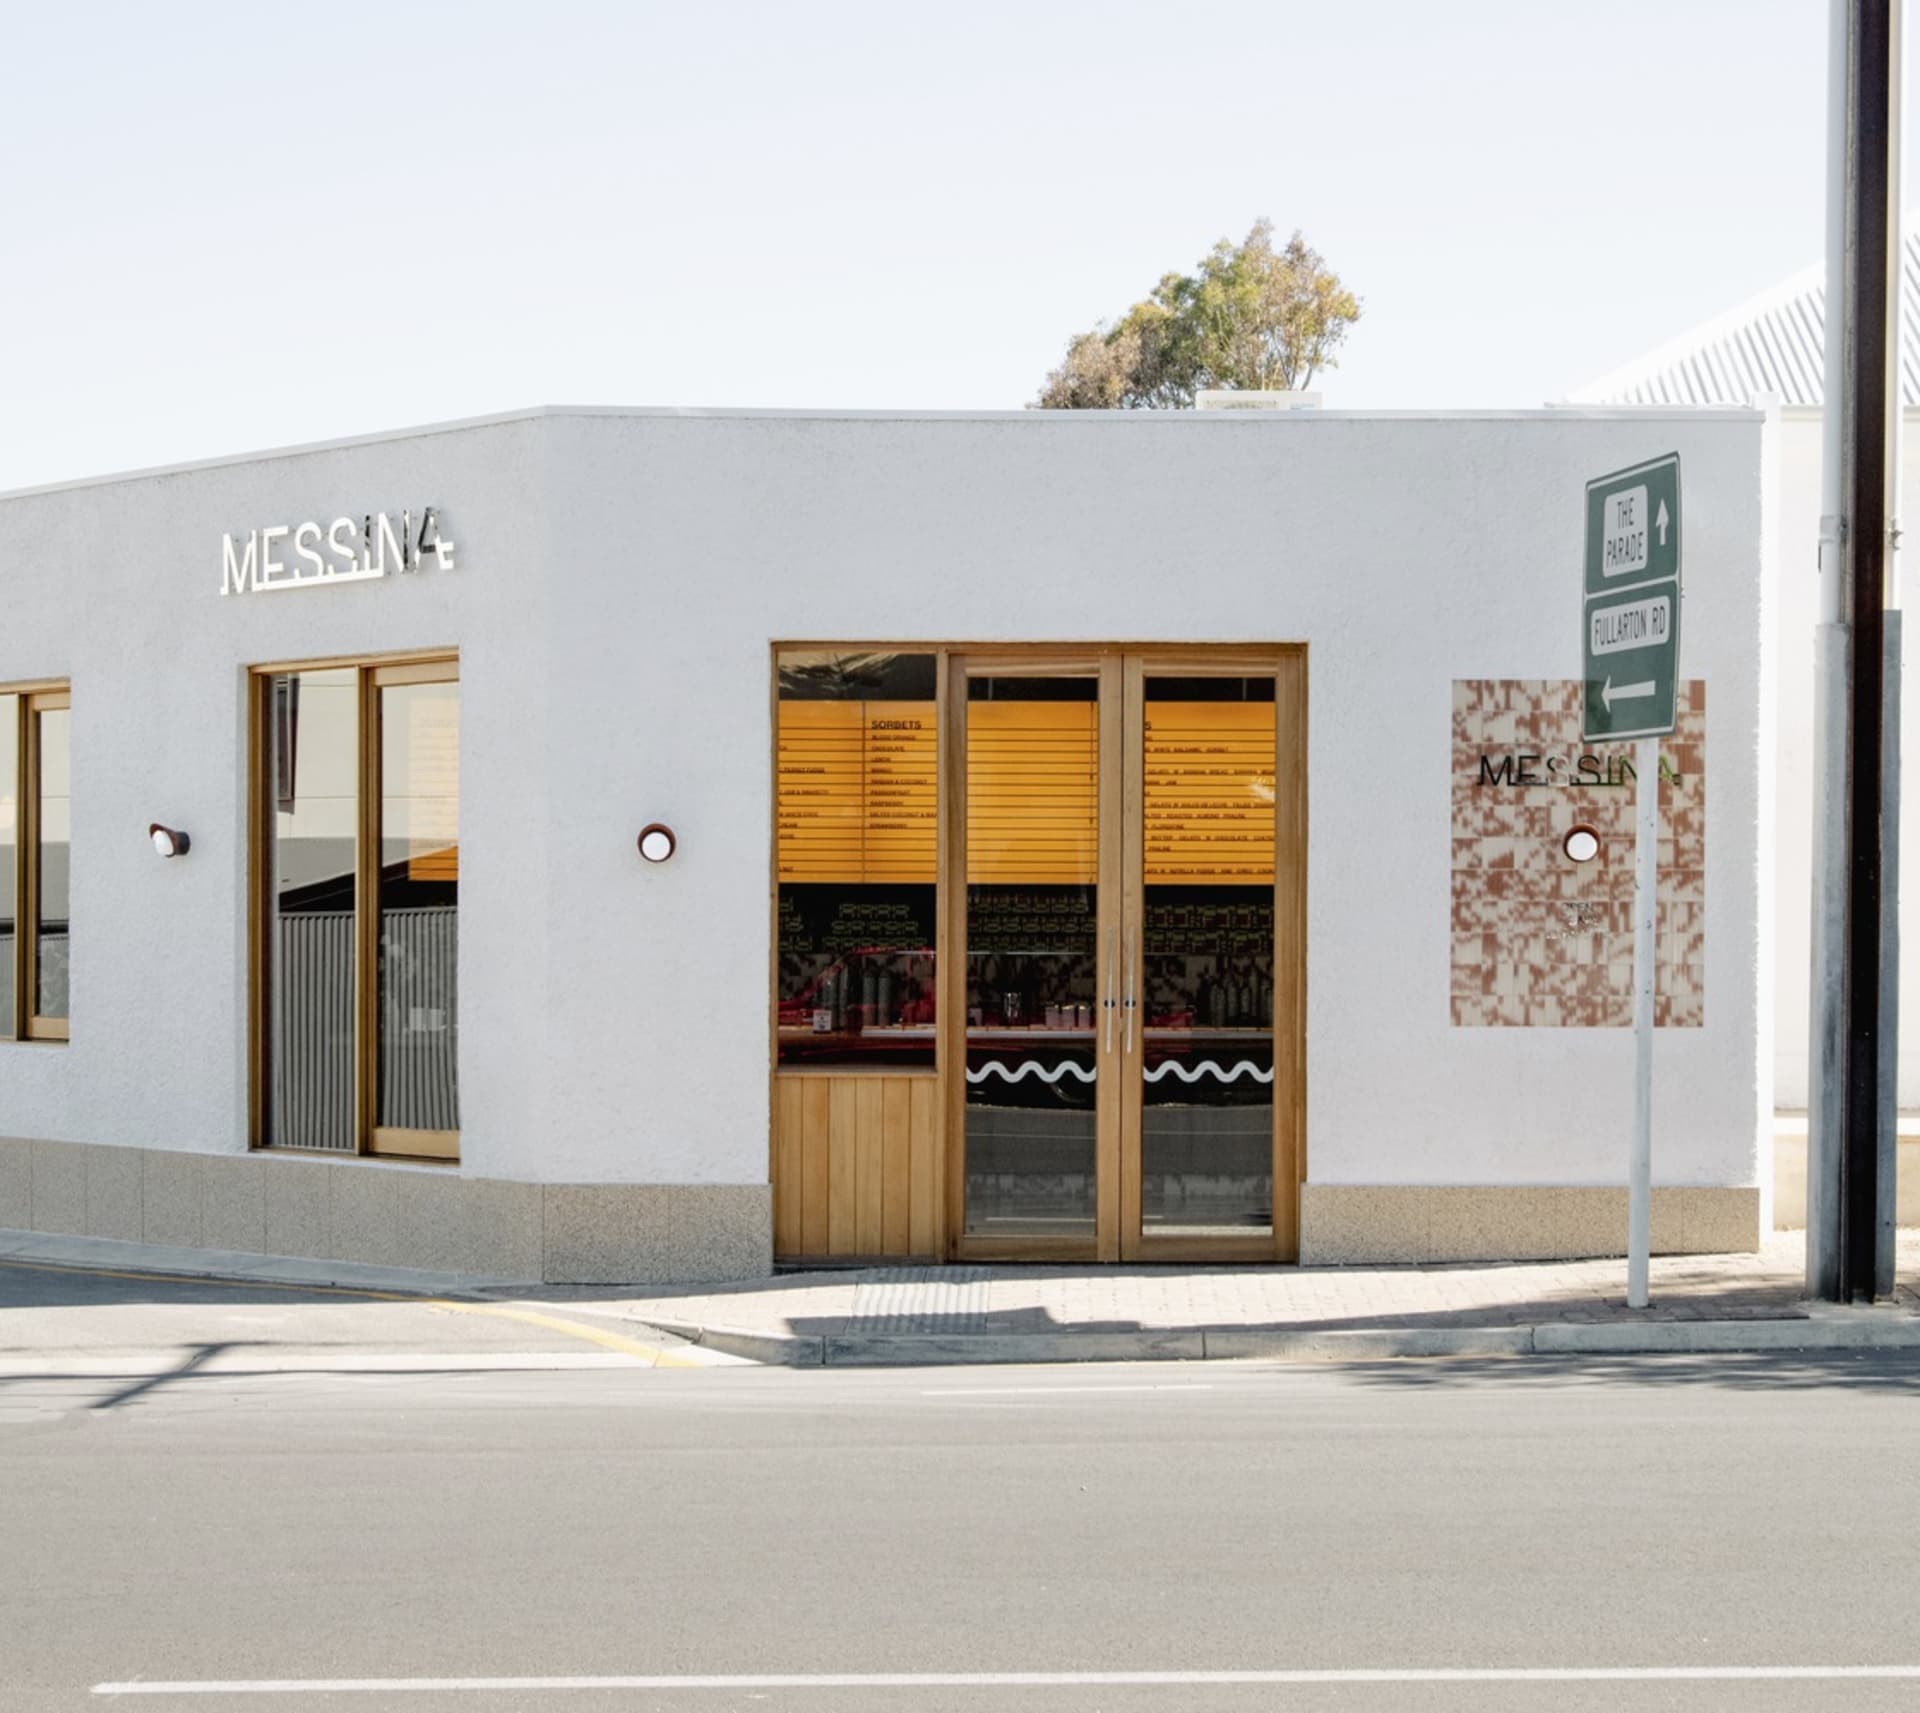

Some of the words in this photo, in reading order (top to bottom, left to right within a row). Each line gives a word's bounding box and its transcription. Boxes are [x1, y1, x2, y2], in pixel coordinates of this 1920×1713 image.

[1617, 497, 1635, 530] THE
[219, 506, 454, 596] MESSINA
[1606, 531, 1644, 569] PARADE
[1594, 610, 1647, 647] FULLARTON
[1652, 605, 1666, 637] RD
[871, 720, 922, 730] SORBETS
